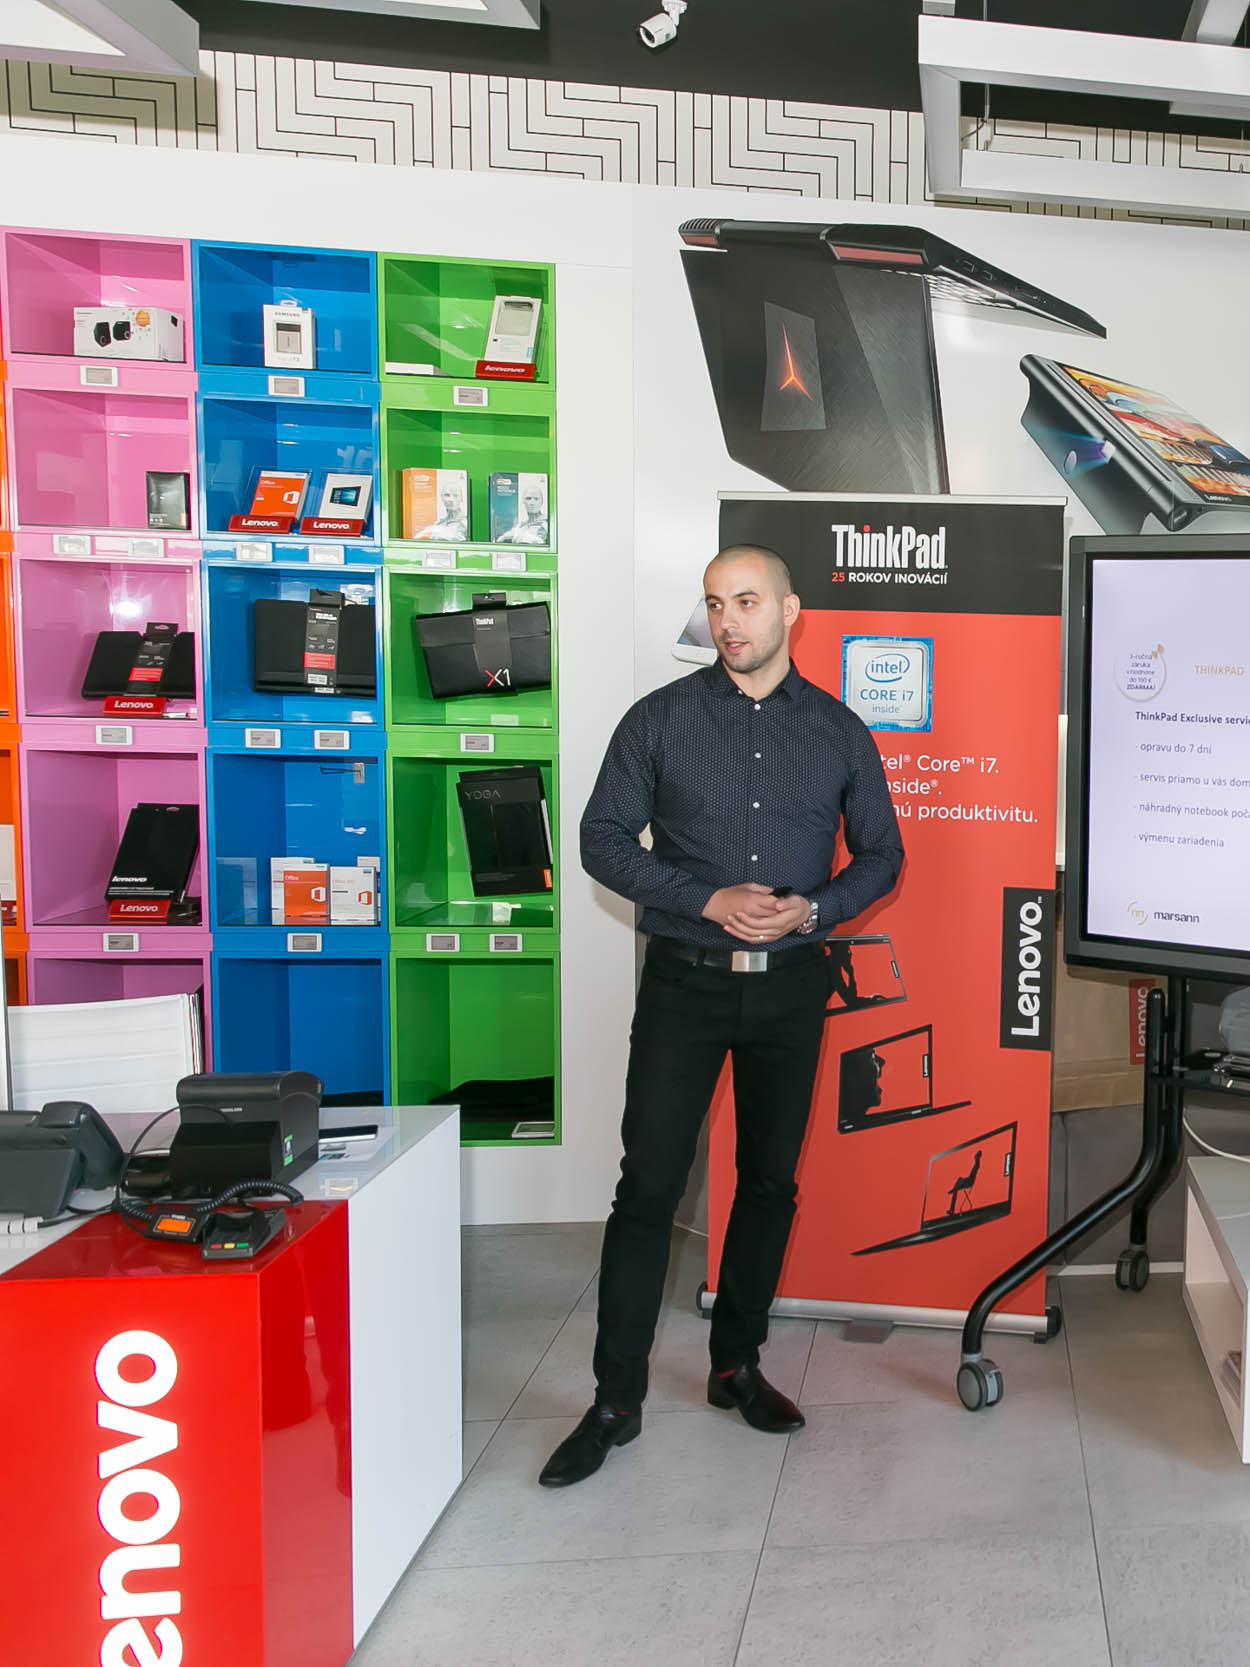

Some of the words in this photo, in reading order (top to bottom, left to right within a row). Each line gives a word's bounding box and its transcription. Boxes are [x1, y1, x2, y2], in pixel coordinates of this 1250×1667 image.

[484, 365, 526, 373] lenovo
[242, 519, 279, 527] Lenovo
[313, 521, 350, 530] Lenovo
[831, 524, 948, 569] ThinkPad
[832, 572, 846, 583] 25
[848, 572, 892, 583] ROKOV
[895, 571, 948, 585] INOVÁCIÍ
[871, 660, 902, 674] intel
[1195, 664, 1244, 676] THINKPAD
[484, 668, 511, 687] X1
[860, 688, 896, 701] CORE
[902, 690, 914, 702] i7
[114, 700, 154, 709] Lenovo
[872, 704, 900, 714] inside
[1135, 711, 1178, 722] ThinkPad
[1180, 713, 1222, 724] Exclusive
[1140, 743, 1172, 754] opravu
[1174, 743, 1186, 753] do
[1188, 744, 1194, 753] 7
[1197, 744, 1212, 754] dní
[980, 756, 1000, 774] i7.
[1140, 773, 1166, 783] servis
[1168, 775, 1200, 786] priamo
[1203, 778, 1210, 786] u
[1212, 777, 1227, 786] vás
[464, 790, 502, 800] YOGA
[918, 804, 1038, 824] produktivitu.
[1139, 802, 1182, 816] náhradný
[1184, 806, 1228, 817] notebook
[1138, 832, 1174, 844] výmenu
[1177, 835, 1225, 848] zariadenia
[120, 904, 158, 912] Lenovo
[1154, 910, 1200, 924] marsann
[94, 1329, 183, 1667] enovo
